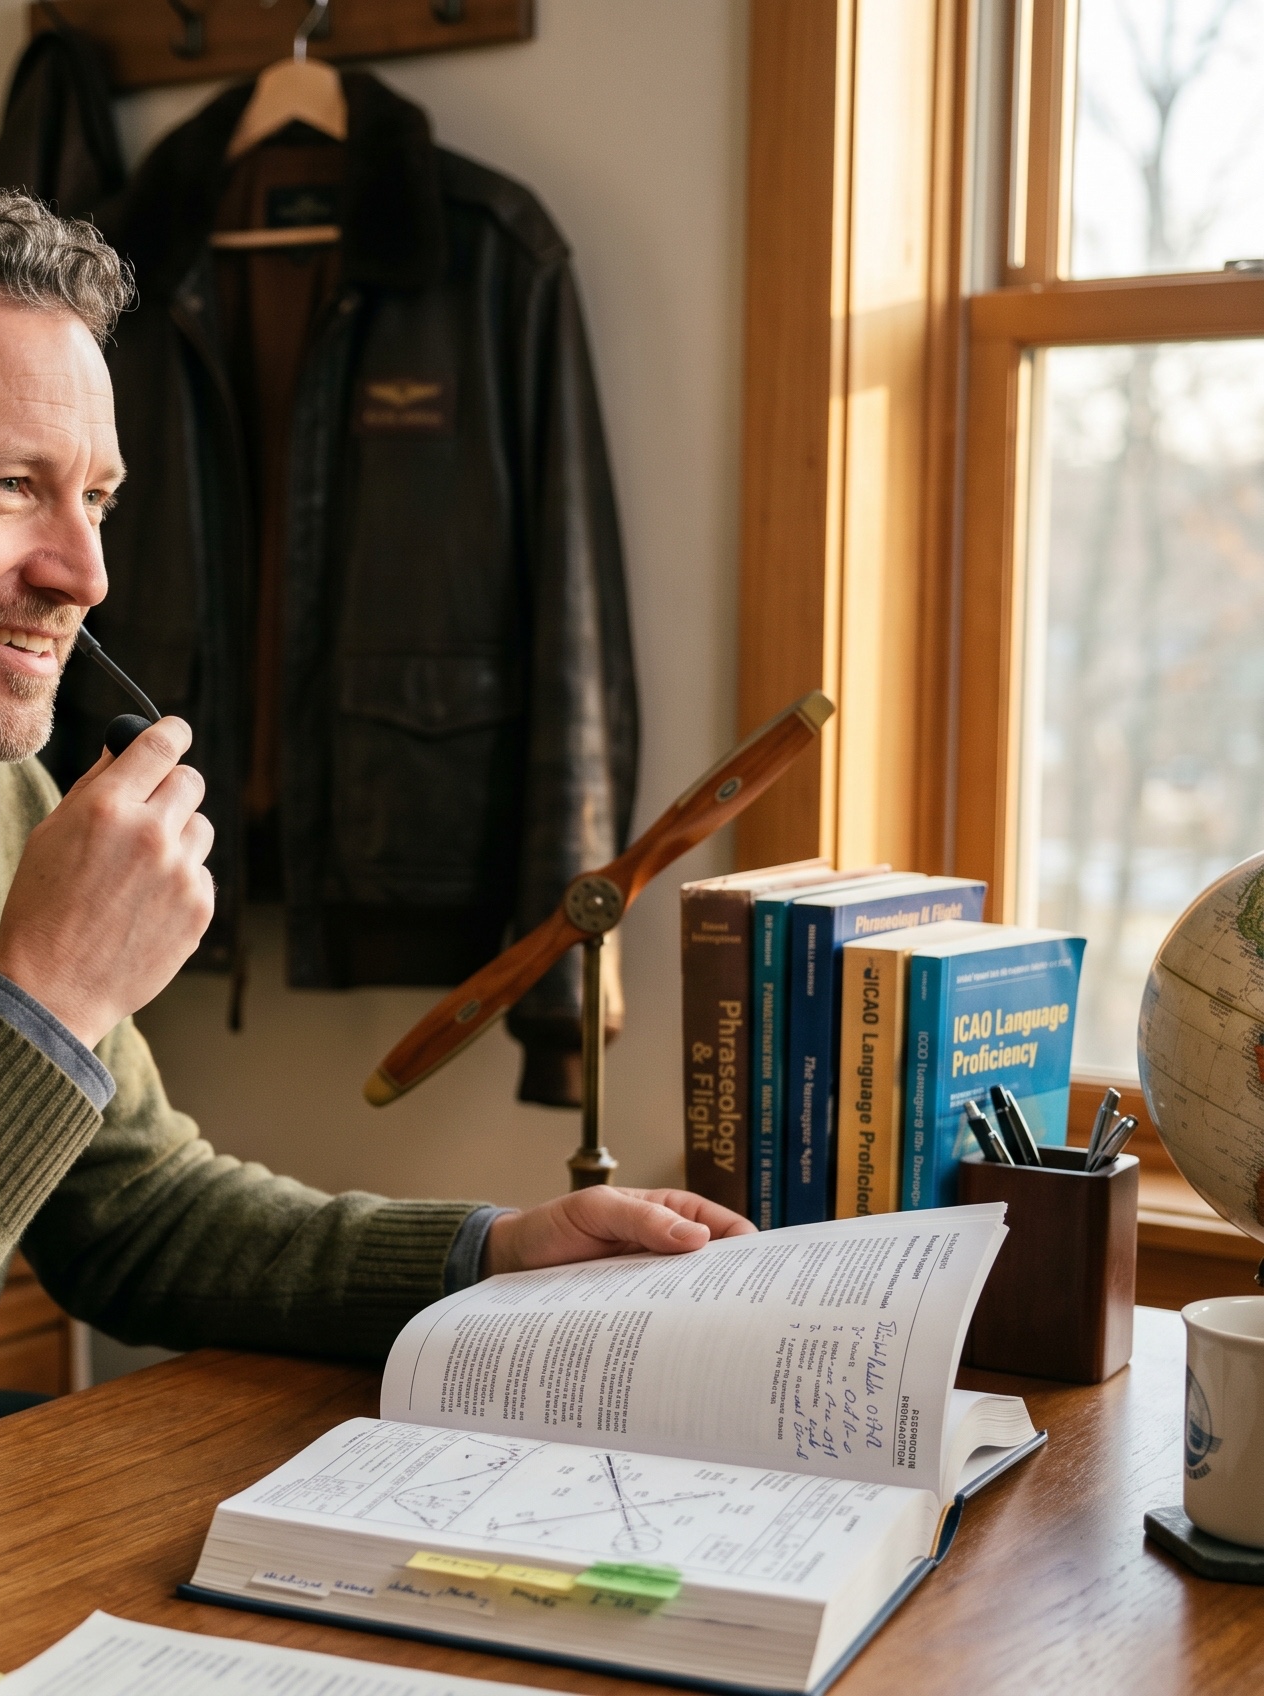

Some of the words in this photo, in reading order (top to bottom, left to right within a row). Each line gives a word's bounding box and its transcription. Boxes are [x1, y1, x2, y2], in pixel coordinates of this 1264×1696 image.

[862, 981, 880, 1025] ICAO
[953, 1010, 992, 1044] ICAO
[995, 1003, 1069, 1037] Language
[692, 1041, 714, 1065] &
[952, 1041, 1038, 1078] Proficiency
[712, 1000, 743, 1173] Phraseology
[856, 1032, 878, 1125] Language
[688, 1073, 715, 1151] Flight
